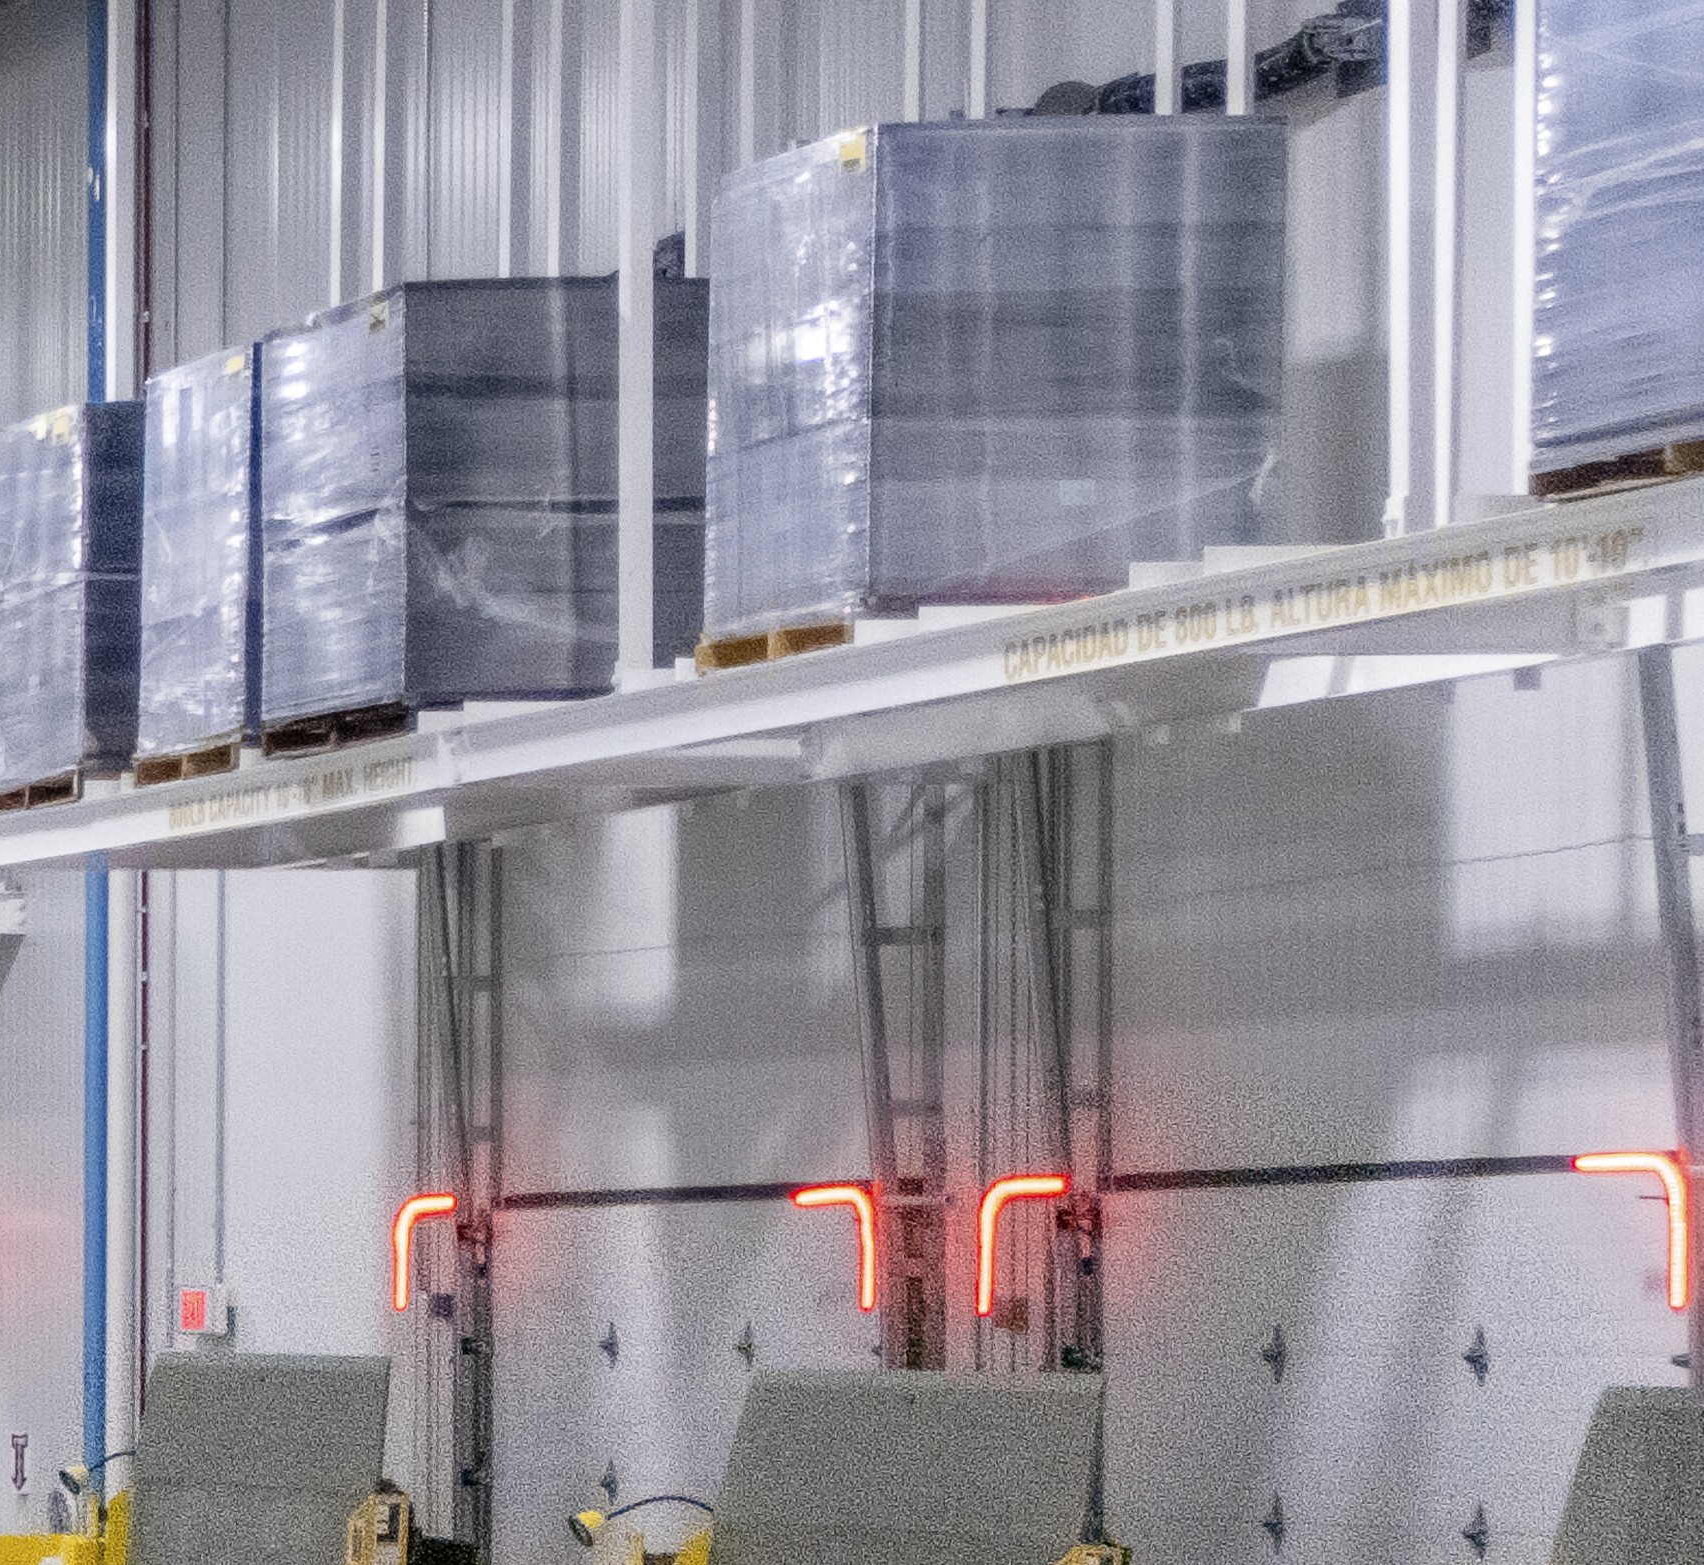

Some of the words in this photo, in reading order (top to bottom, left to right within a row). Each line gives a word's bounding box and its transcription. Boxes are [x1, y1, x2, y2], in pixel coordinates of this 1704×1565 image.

[1003, 617, 1128, 681] CAPACIDAD
[1136, 610, 1168, 653] DE
[1174, 600, 1217, 646] 800
[1270, 573, 1371, 629] ALTURA
[1503, 542, 1539, 586] DE
